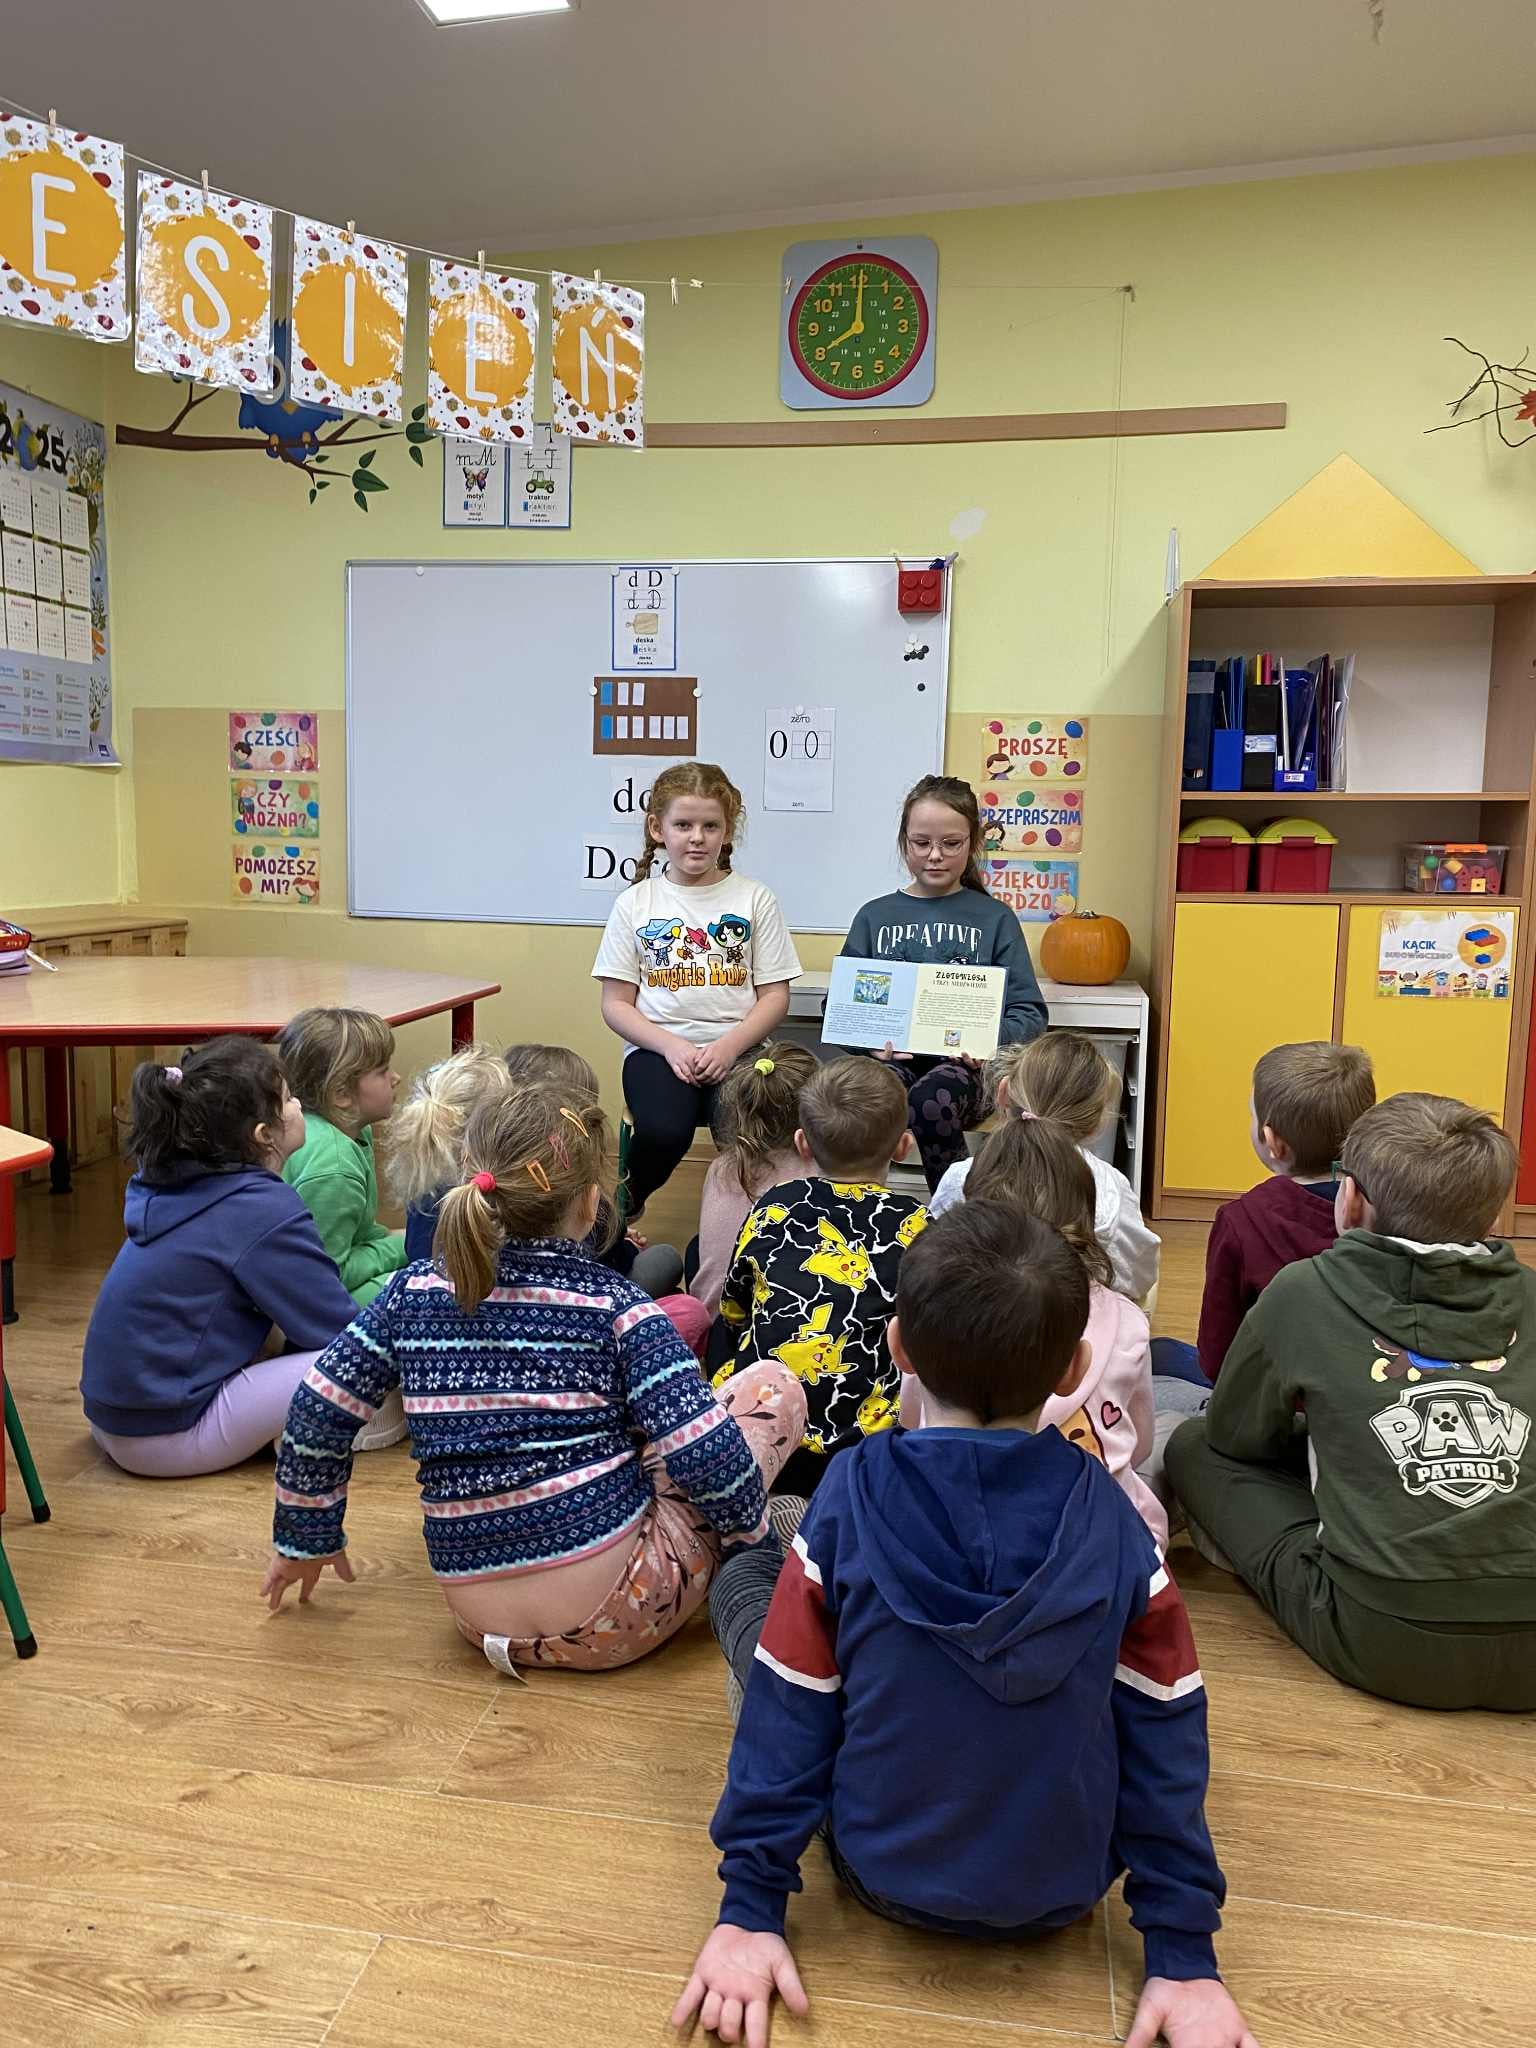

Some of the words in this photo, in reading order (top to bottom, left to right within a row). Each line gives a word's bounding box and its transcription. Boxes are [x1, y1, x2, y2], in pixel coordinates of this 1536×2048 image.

[850, 274, 868, 288] 12
[881, 281, 889, 294] 1
[828, 282, 843, 297] 11
[814, 299, 833, 313] 10
[893, 296, 905, 310] 2
[808, 322, 820, 336] 9
[898, 319, 909, 333] 3
[815, 347, 826, 361] 8
[888, 344, 901, 358] 4
[830, 361, 841, 375] 7
[852, 365, 863, 379] 6
[873, 360, 885, 374] 5
[628, 571, 638, 587] d
[648, 570, 662, 587] D
[244, 727, 300, 747] CZEŚĆ!
[770, 730, 787, 758] 0
[805, 730, 818, 758] 0
[998, 737, 1068, 759] PROSZĘ
[257, 792, 290, 808] CZY
[242, 809, 307, 828] MOŻNA?
[980, 808, 1082, 826] PRZEPRASZAM
[235, 856, 316, 875] POMOŻESZ
[260, 879, 290, 894] MI?
[978, 870, 1070, 894] DZIĘKUJĘ
[877, 922, 982, 963] CREATIVE
[1403, 940, 1436, 953] KĄCIK
[1369, 1400, 1531, 1464] PAW
[1416, 1462, 1506, 1483] PATROL
